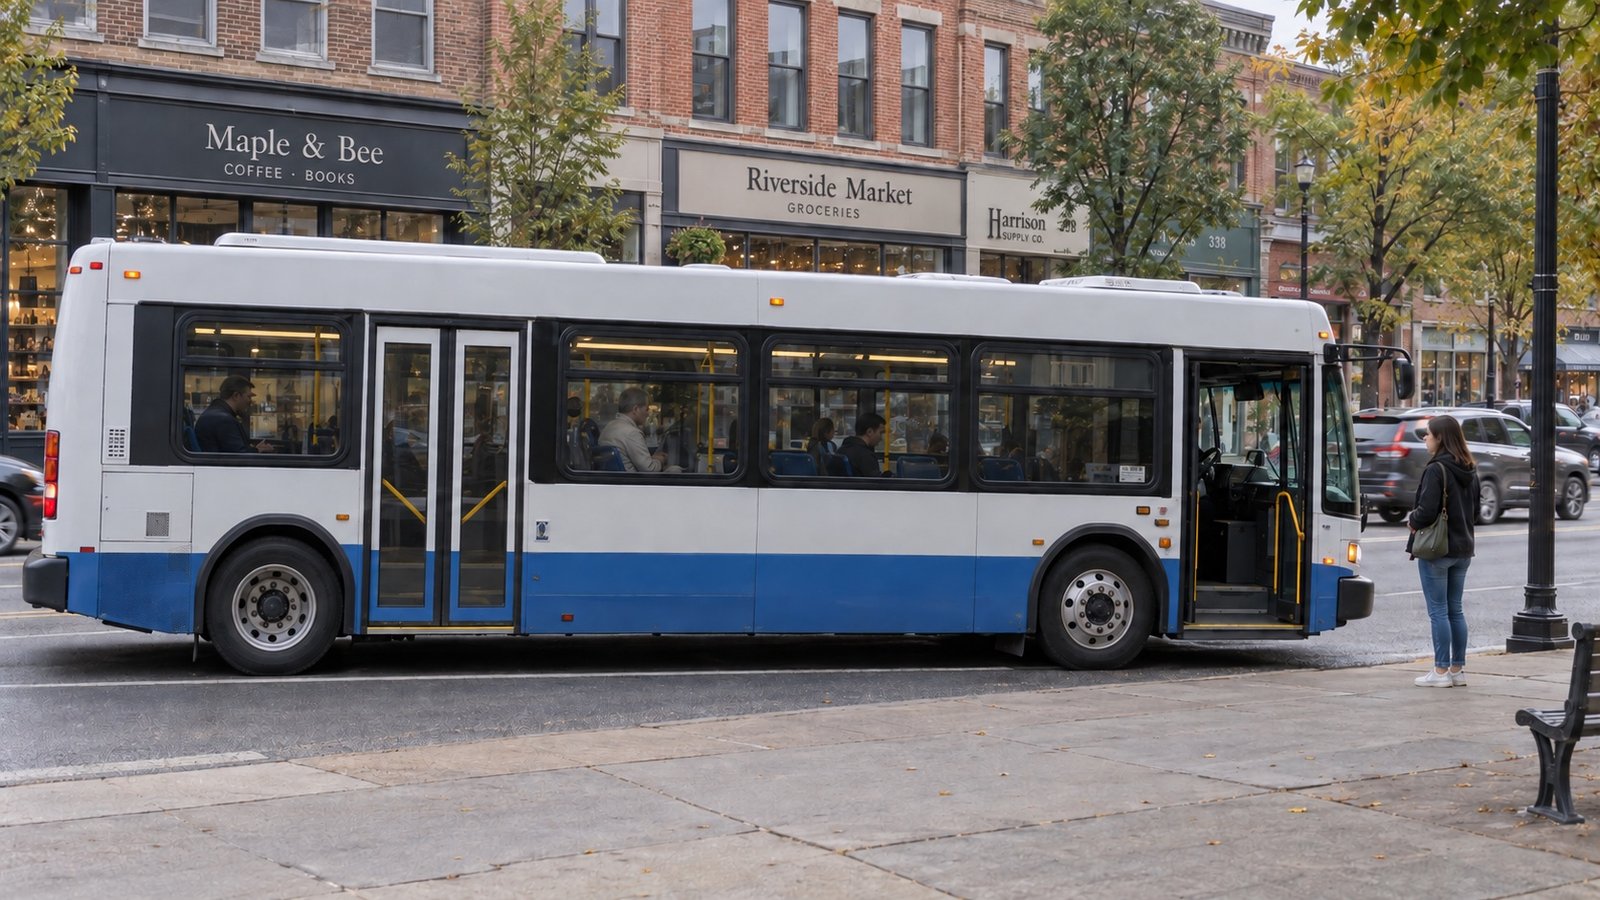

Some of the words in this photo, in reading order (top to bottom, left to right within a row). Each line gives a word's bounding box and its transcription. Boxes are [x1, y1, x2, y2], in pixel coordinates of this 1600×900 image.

[205, 123, 290, 161] Maple
[303, 133, 325, 159] &
[338, 136, 384, 164] Bee
[224, 163, 283, 180] COFFEE
[305, 170, 355, 185] BOOKS
[747, 167, 837, 199] Riverside
[846, 177, 913, 205] Market
[787, 203, 861, 219] GROCERIES
[987, 208, 1046, 240] Harrison
[1002, 231, 1030, 242] SUPPLY
[1031, 234, 1044, 244] CO.
[1208, 235, 1226, 249] 338
